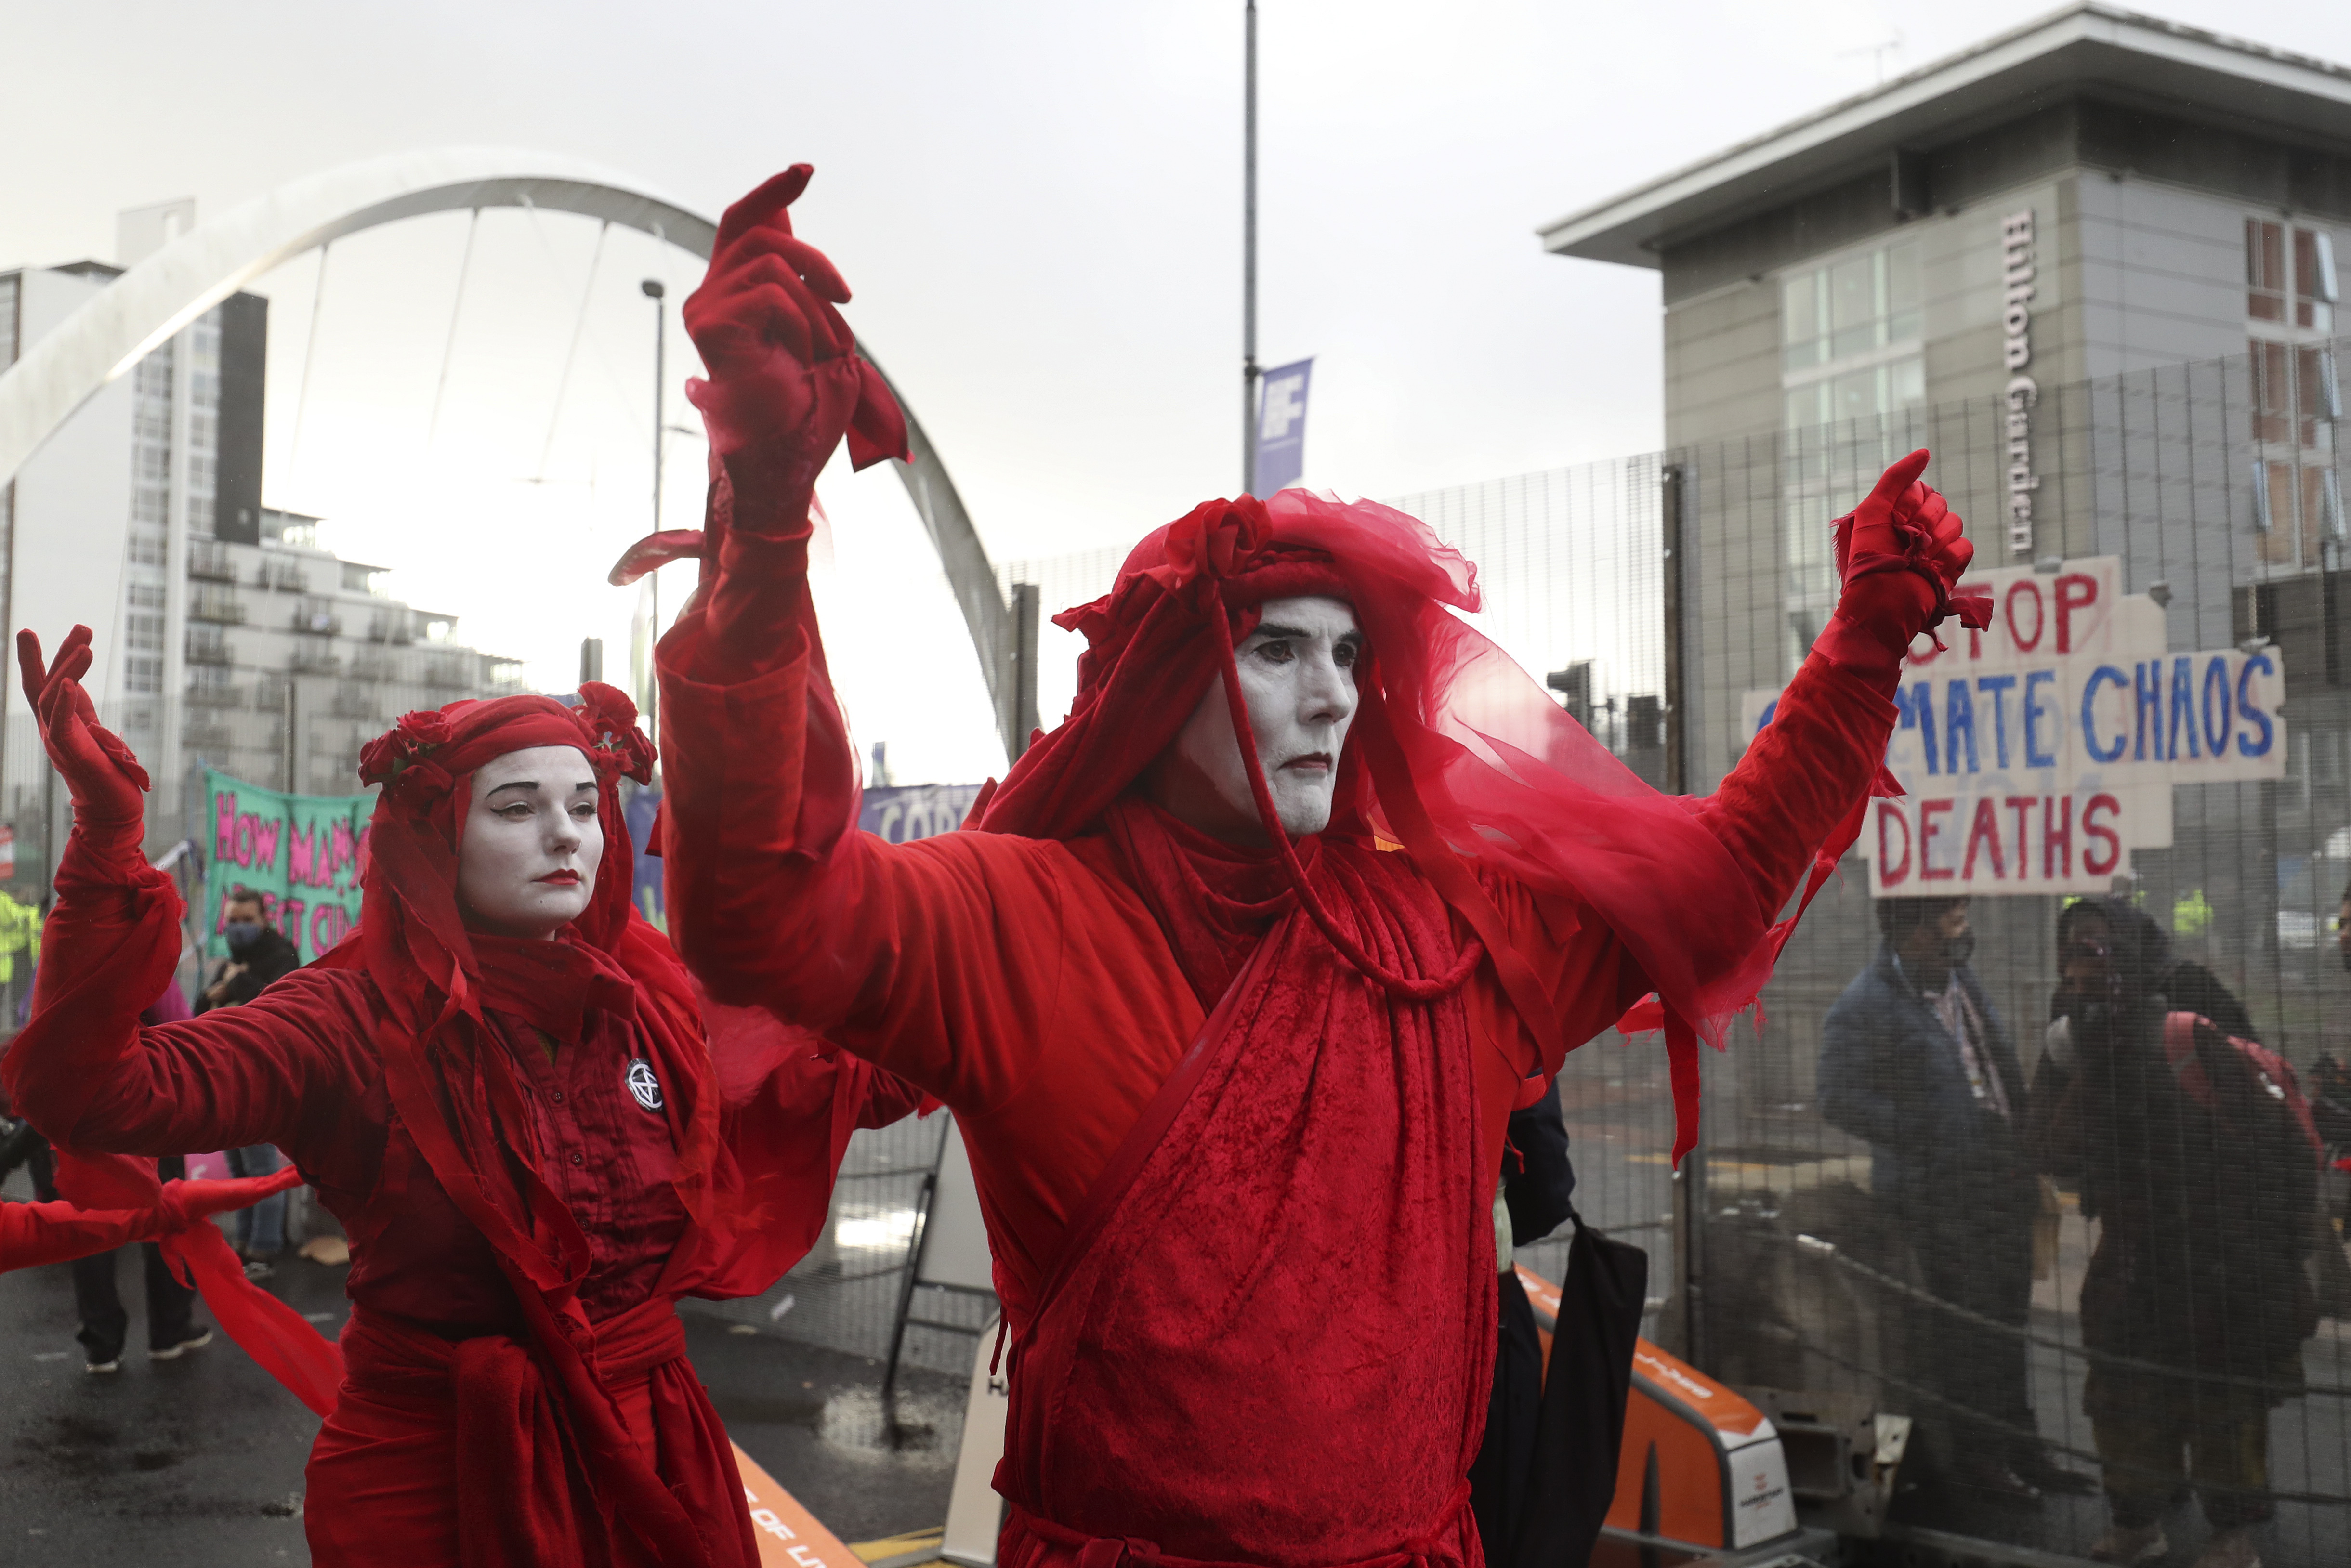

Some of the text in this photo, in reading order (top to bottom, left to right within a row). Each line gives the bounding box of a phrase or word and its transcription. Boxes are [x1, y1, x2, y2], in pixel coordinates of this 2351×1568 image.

[2002, 208, 2036, 372] Hilton
[2082, 654, 2275, 763] CHAOS
[215, 790, 282, 873] HOW
[1878, 793, 2121, 890] DEATHS
[750, 1507, 797, 1541] OF
